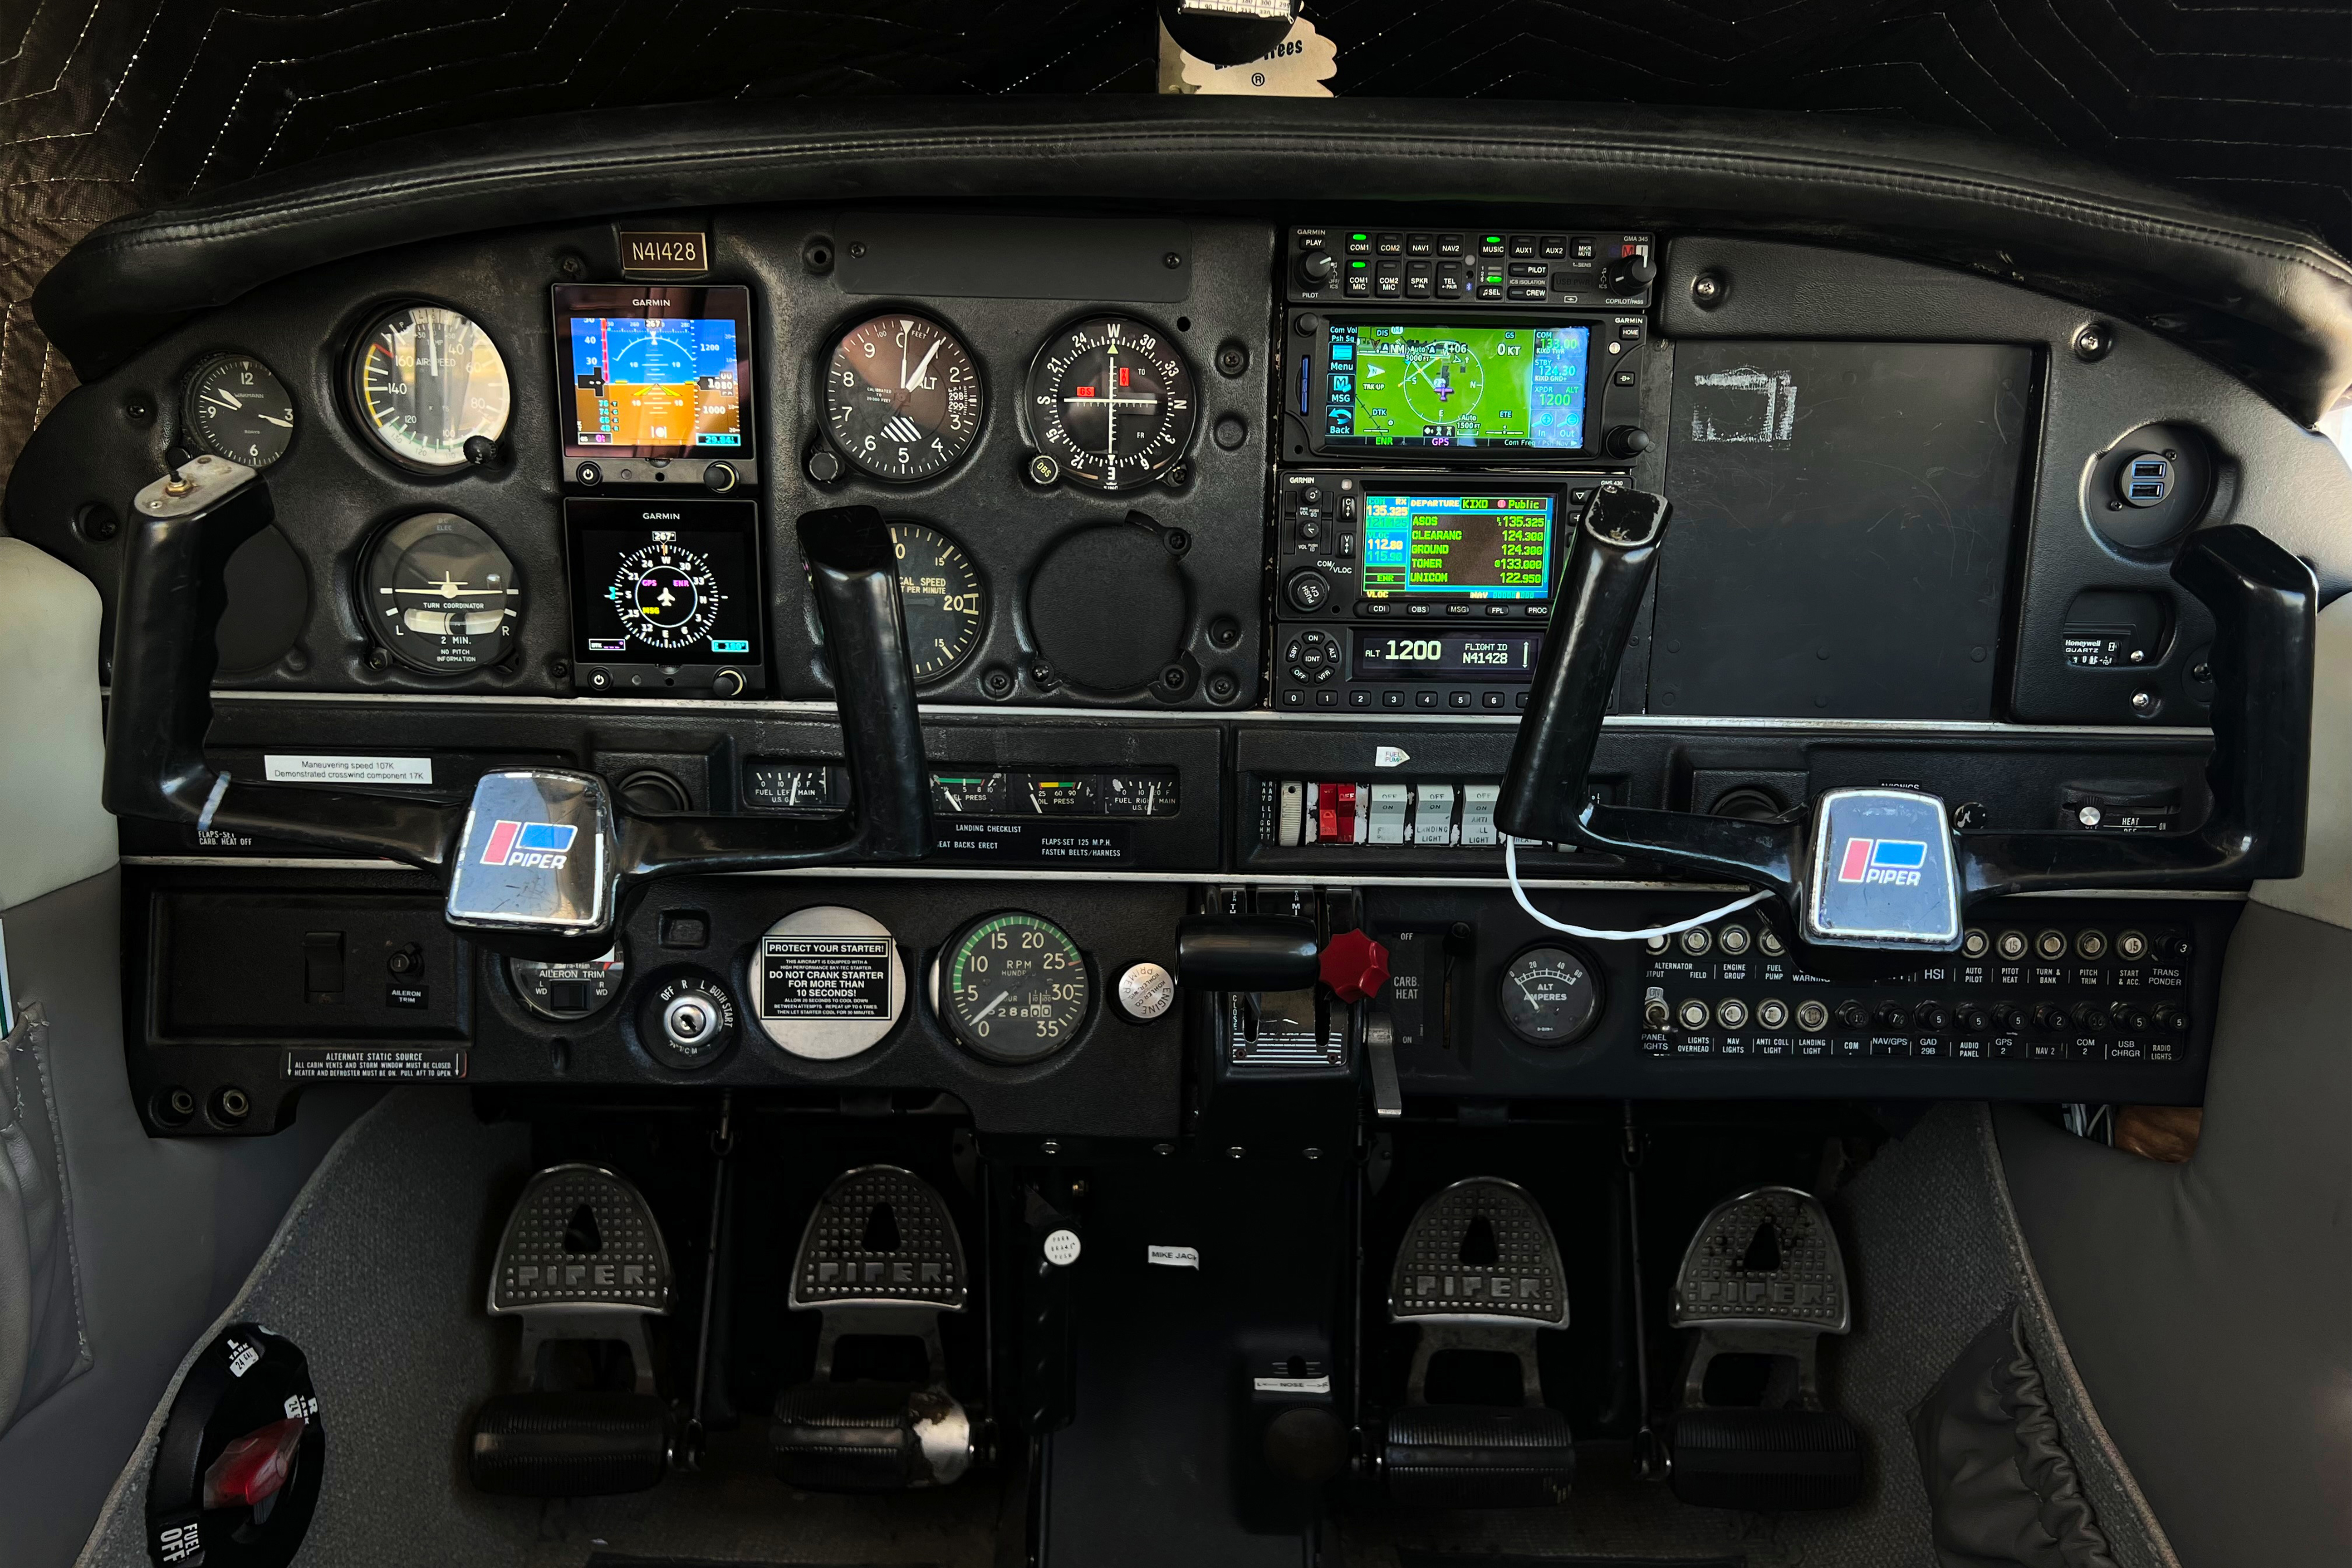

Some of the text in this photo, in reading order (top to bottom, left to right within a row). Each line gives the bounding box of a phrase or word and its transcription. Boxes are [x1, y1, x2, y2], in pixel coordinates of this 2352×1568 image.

[632, 242, 696, 261] N41428
[632, 299, 671, 307] GARMIN
[911, 330, 927, 339] FEET
[1107, 323, 1121, 338] W
[1139, 333, 1156, 350] 30
[1540, 338, 1578, 349] 133.00
[1330, 362, 1353, 371] Menu
[1539, 365, 1576, 377] 124.30
[241, 372, 254, 386] 12
[388, 382, 407, 395] 140
[1331, 394, 1351, 402] MSG
[1539, 394, 1571, 406] 1200
[1330, 426, 1350, 434] Back
[1376, 437, 1393, 445] ENR
[1431, 438, 1450, 446] GPS
[898, 447, 910, 464] 5
[1036, 461, 1052, 478] OBS
[1411, 499, 1460, 507] DEPARTURE
[1508, 499, 1540, 509] Public
[1367, 506, 1408, 517] 135.325
[1412, 516, 1545, 527] ASOS 135.325
[1412, 530, 1544, 541] CLEARANC 124.300
[1411, 544, 1543, 555] GROUND 124.300
[1411, 558, 1542, 569] TOWER 133.000
[920, 578, 946, 587] SPEED
[1410, 572, 1542, 583] UNICOM 122.950
[943, 595, 965, 611] 20
[452, 637, 472, 645] MIN.
[1385, 640, 1441, 660] 1200
[1462, 652, 1508, 664] N41428
[301, 761, 349, 769] Maneuvering
[956, 824, 1022, 833] LANDING CHECKLIST
[508, 852, 568, 870] PIPER
[1866, 868, 1922, 887] PIPER
[769, 944, 884, 953] PROTECT YOUR STARTER!
[1043, 953, 1065, 970] 25
[539, 970, 605, 979] AILERON TRIM
[1924, 969, 1945, 980] HSI
[810, 980, 837, 988] MORE
[2148, 977, 2182, 986] PONDER
[709, 985, 726, 1004] BOTH
[808, 989, 856, 997] SECONDS!
[1396, 989, 1418, 1000] HEAT
[1872, 1037, 1908, 1045] NAV/GPS
[326, 1053, 423, 1061] ALTERNATE STATIC SOURCE
[2111, 1049, 2141, 1057] CHRGR
[2151, 1052, 2172, 1060] LIGHTS
[183, 1523, 200, 1555] FUEL
[160, 1528, 184, 1562] OFF
